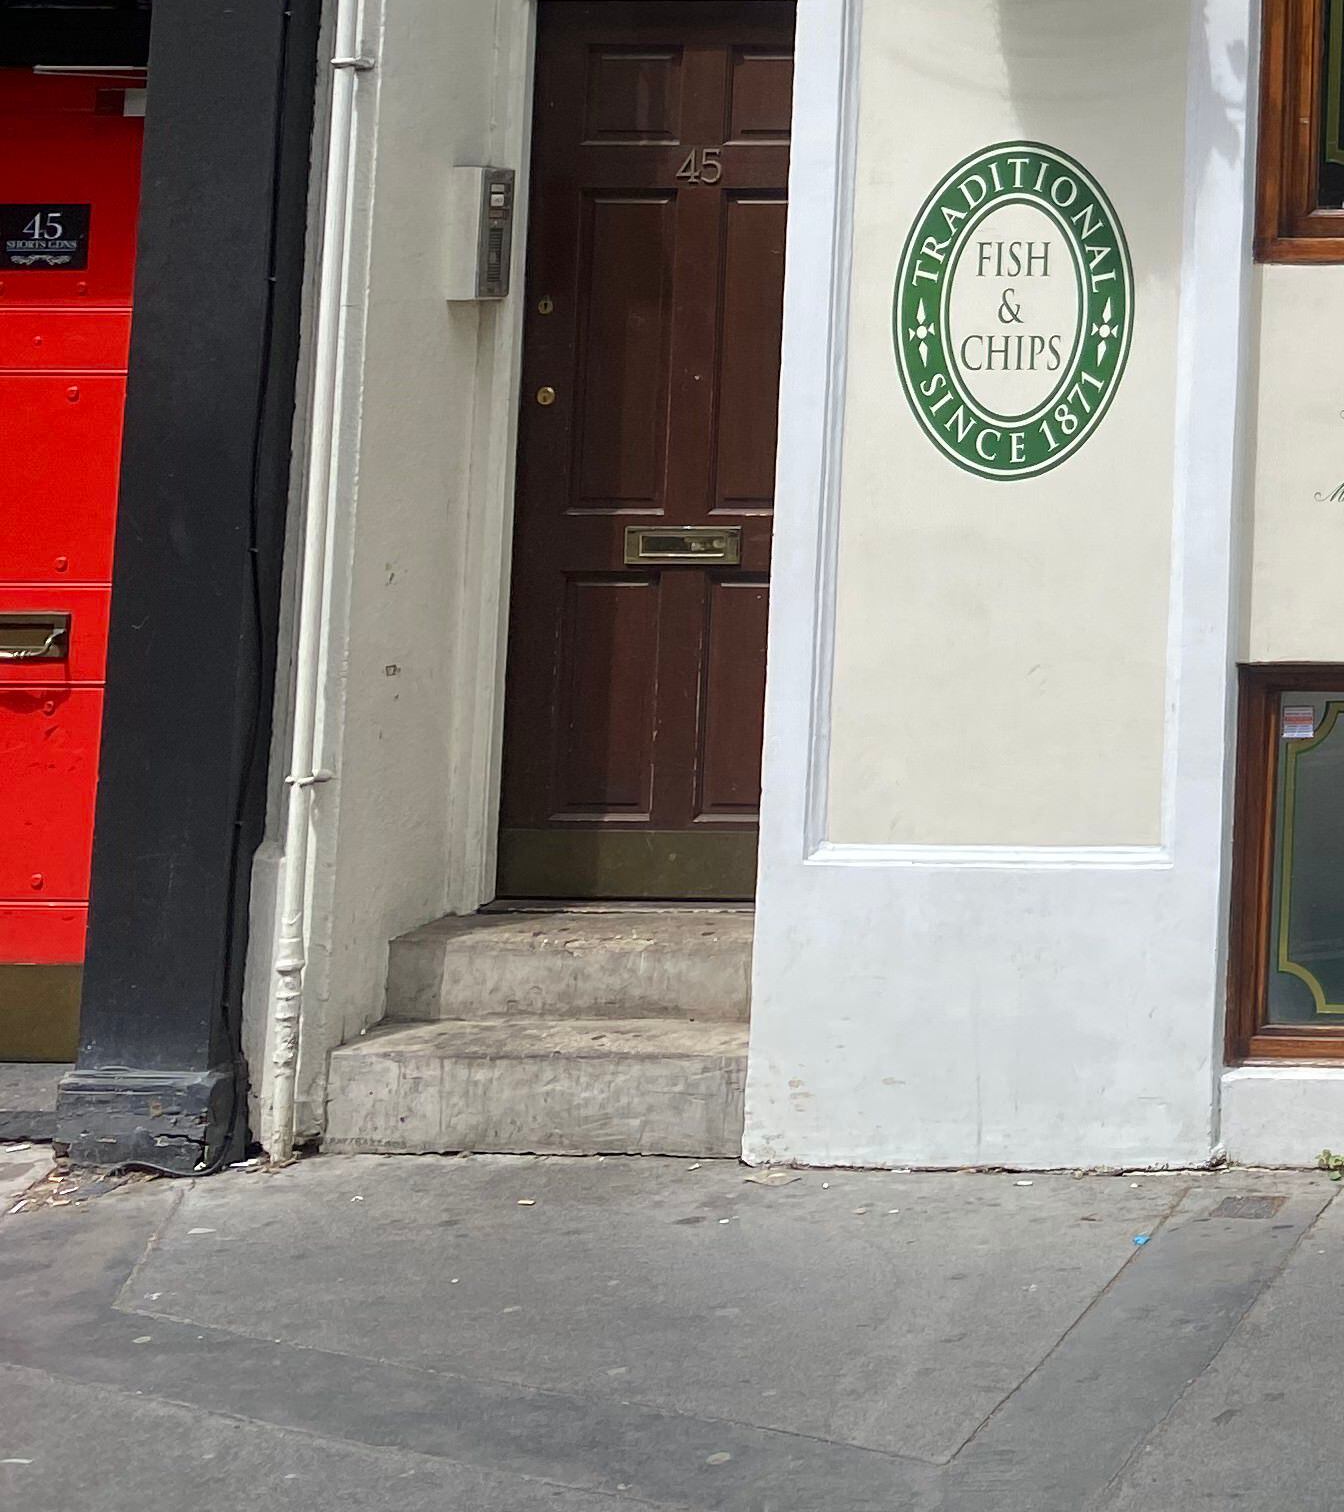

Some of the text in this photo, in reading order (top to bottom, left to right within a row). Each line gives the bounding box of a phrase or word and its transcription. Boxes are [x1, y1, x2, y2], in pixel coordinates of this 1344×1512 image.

[675, 147, 723, 185] 45
[22, 212, 62, 239] 45
[912, 157, 1117, 293] TRADITIONAL
[976, 241, 1050, 278] FISH
[998, 288, 1025, 324] &
[960, 335, 1062, 372] CHIPS
[920, 369, 1106, 464] SINCE 1871
